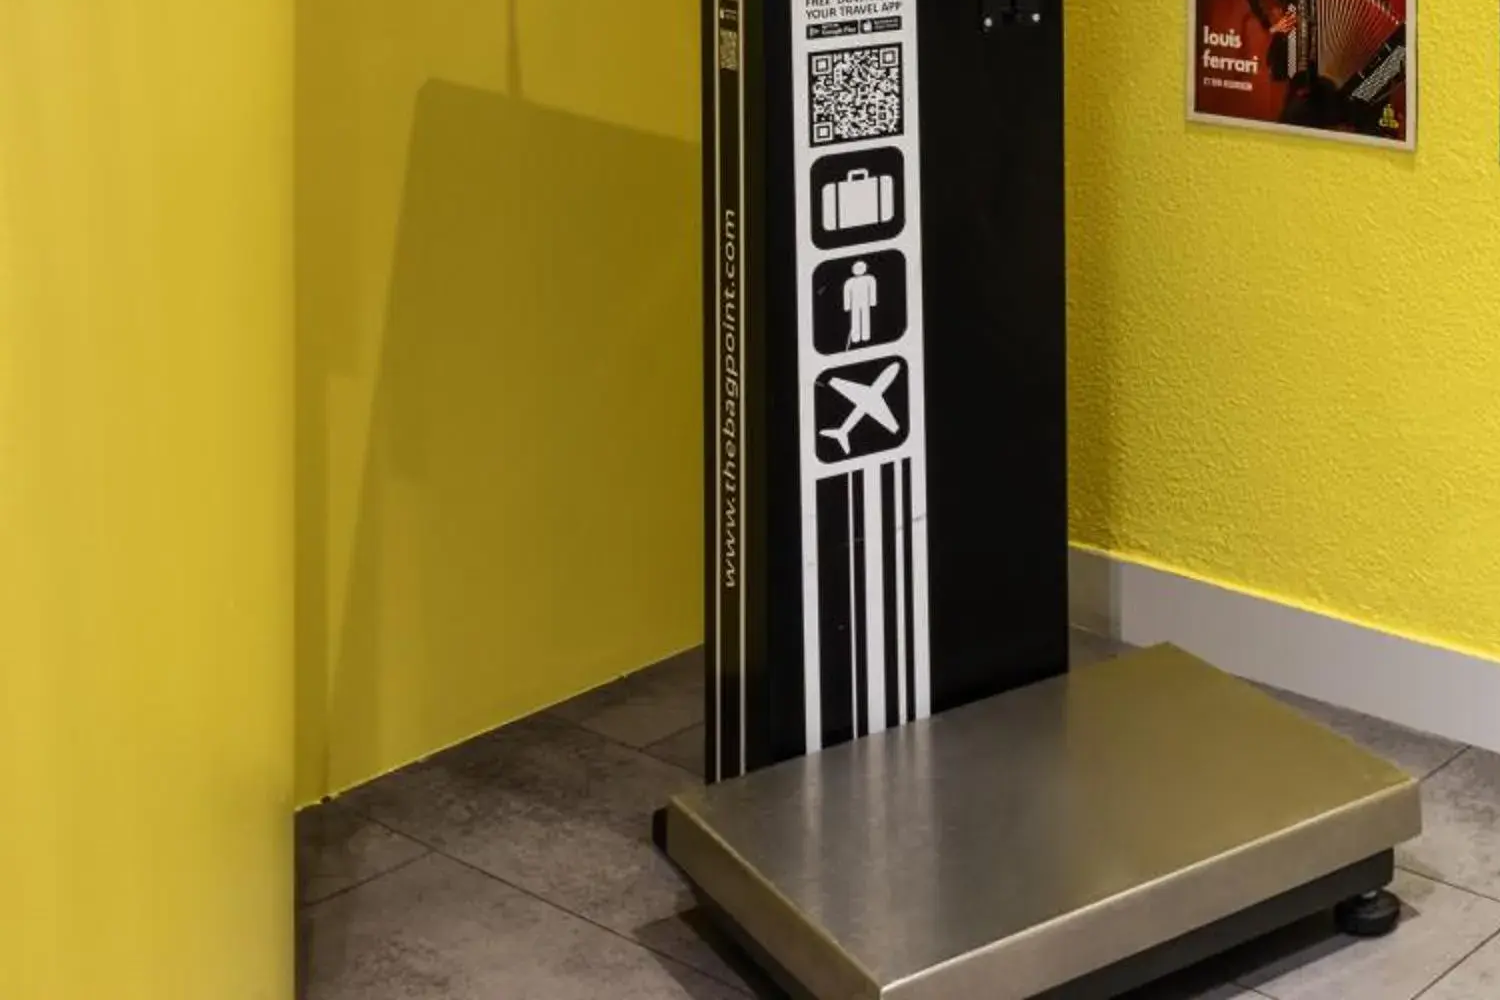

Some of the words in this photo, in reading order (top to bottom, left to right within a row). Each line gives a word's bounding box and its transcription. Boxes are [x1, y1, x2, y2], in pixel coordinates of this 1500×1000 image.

[806, 8, 836, 20] YOUR
[839, 3, 878, 17] TRAVEL
[881, 1, 902, 12] APP
[1203, 25, 1242, 48] louis
[1203, 49, 1258, 74] ferrari
[722, 209, 739, 588] www.thebagpoint.com
